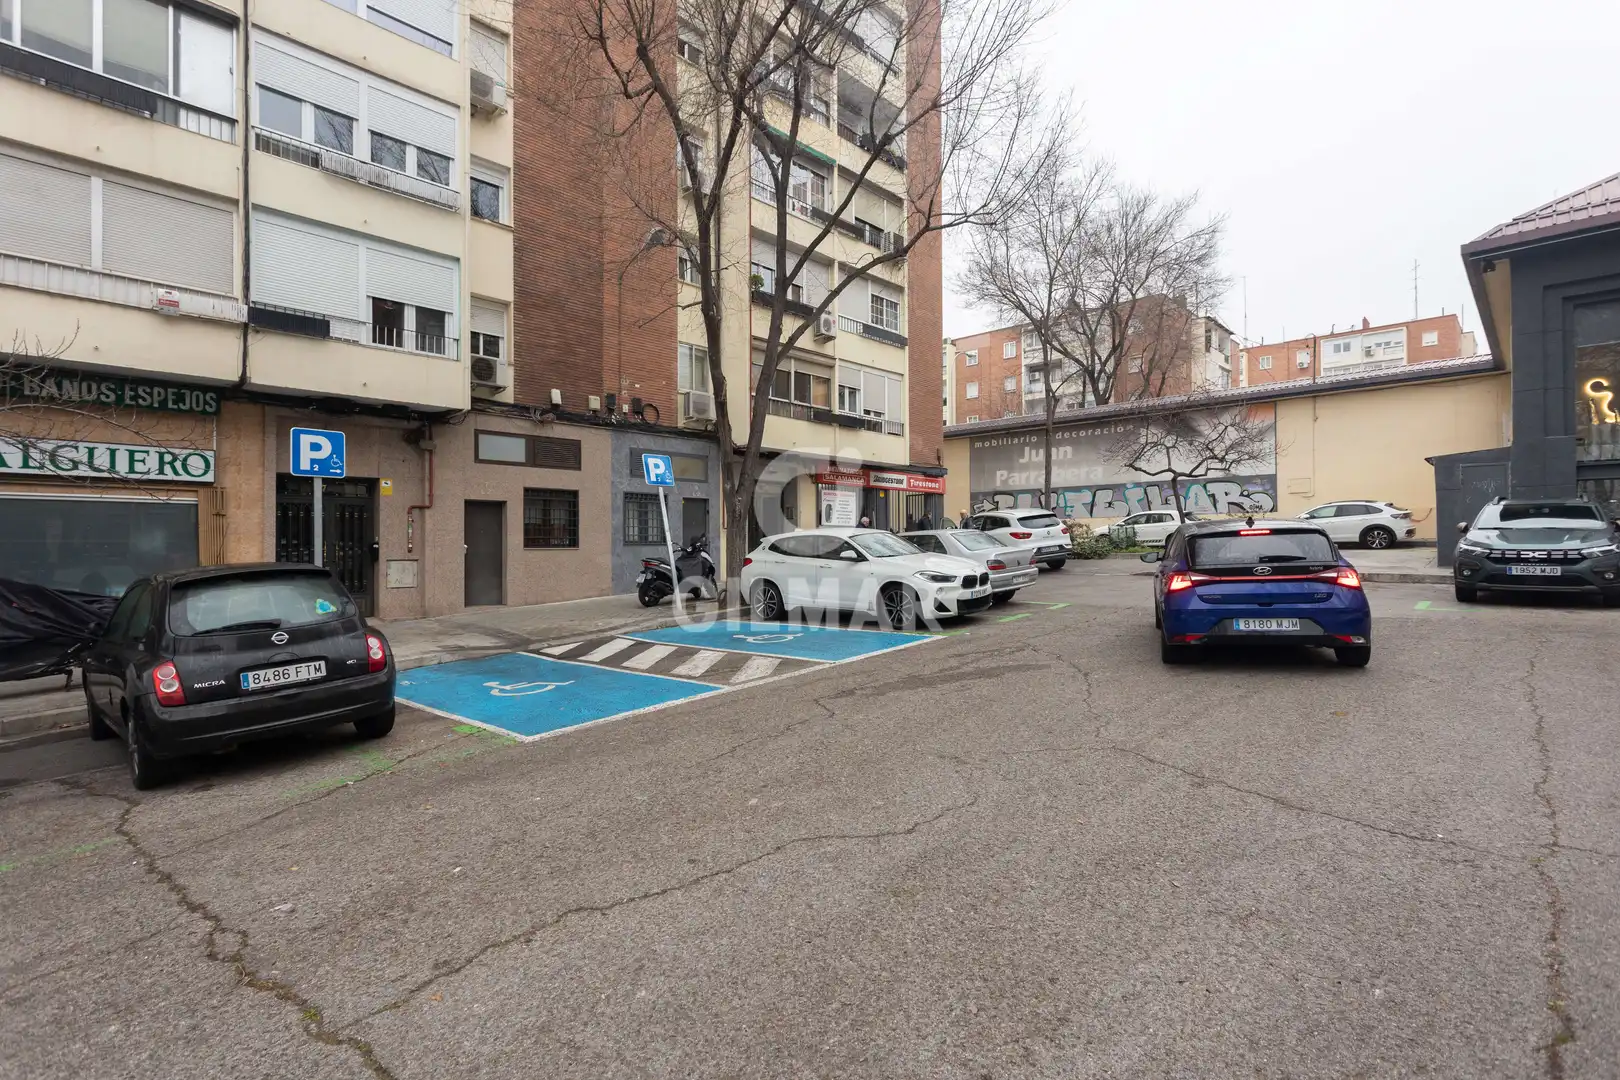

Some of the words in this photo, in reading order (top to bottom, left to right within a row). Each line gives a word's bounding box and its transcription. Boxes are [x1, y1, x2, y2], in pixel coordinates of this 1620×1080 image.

[125, 384, 217, 412] ESPEJOS
[974, 434, 1038, 449] mobiliario
[300, 434, 332, 471] P
[647, 457, 666, 482] P
[824, 474, 865, 484] SALAMANCA
[873, 475, 905, 485] BRIDGESTONE
[910, 479, 940, 488] Firestone
[1243, 620, 1273, 629] 8180
[1276, 620, 1299, 629] MJM
[252, 668, 291, 685] 8486
[295, 663, 323, 678] FTM
[193, 679, 226, 689] MICRA
